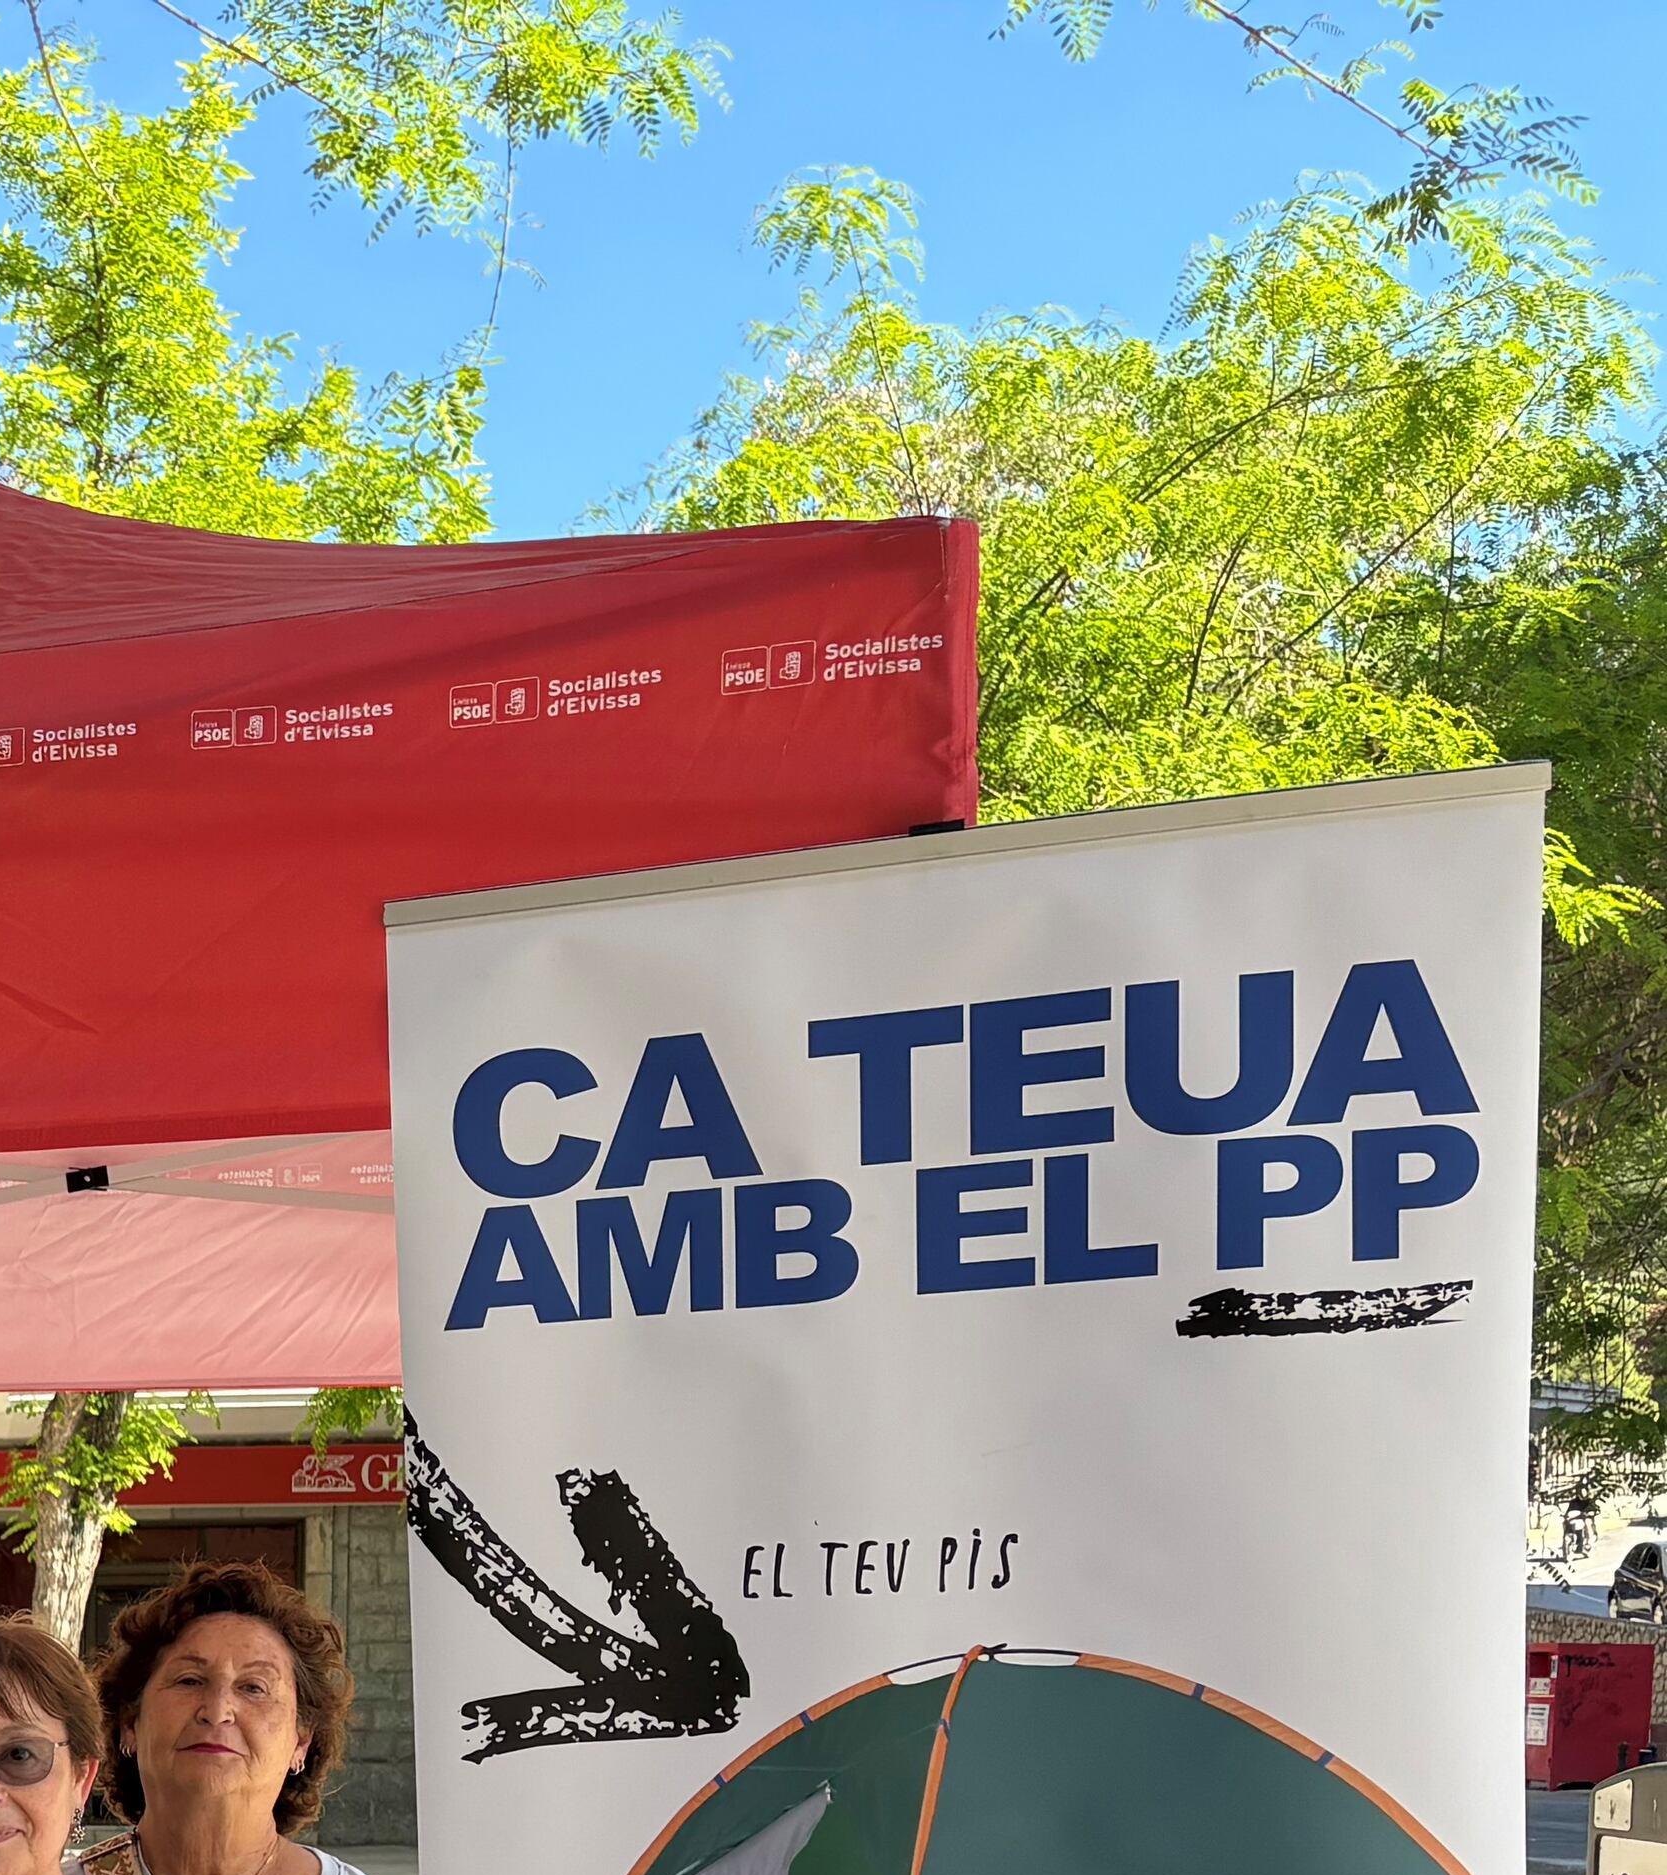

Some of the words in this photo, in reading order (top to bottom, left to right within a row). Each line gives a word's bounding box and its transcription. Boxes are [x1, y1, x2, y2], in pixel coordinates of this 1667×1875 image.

[825, 632, 943, 660] Socialistes
[548, 667, 662, 697] Socialistes
[725, 669, 765, 687] PSOE
[284, 701, 393, 723] Socialistes
[453, 703, 491, 720] PSOE
[32, 720, 137, 743] Socialistes
[194, 726, 230, 742] PSOE
[452, 1031, 763, 1199] CA
[808, 958, 1481, 1167] TEUA
[444, 1177, 859, 1331] AMB
[915, 1153, 1158, 1295] EL
[1215, 1123, 1481, 1270] PP
[743, 1545, 793, 1599] EL
